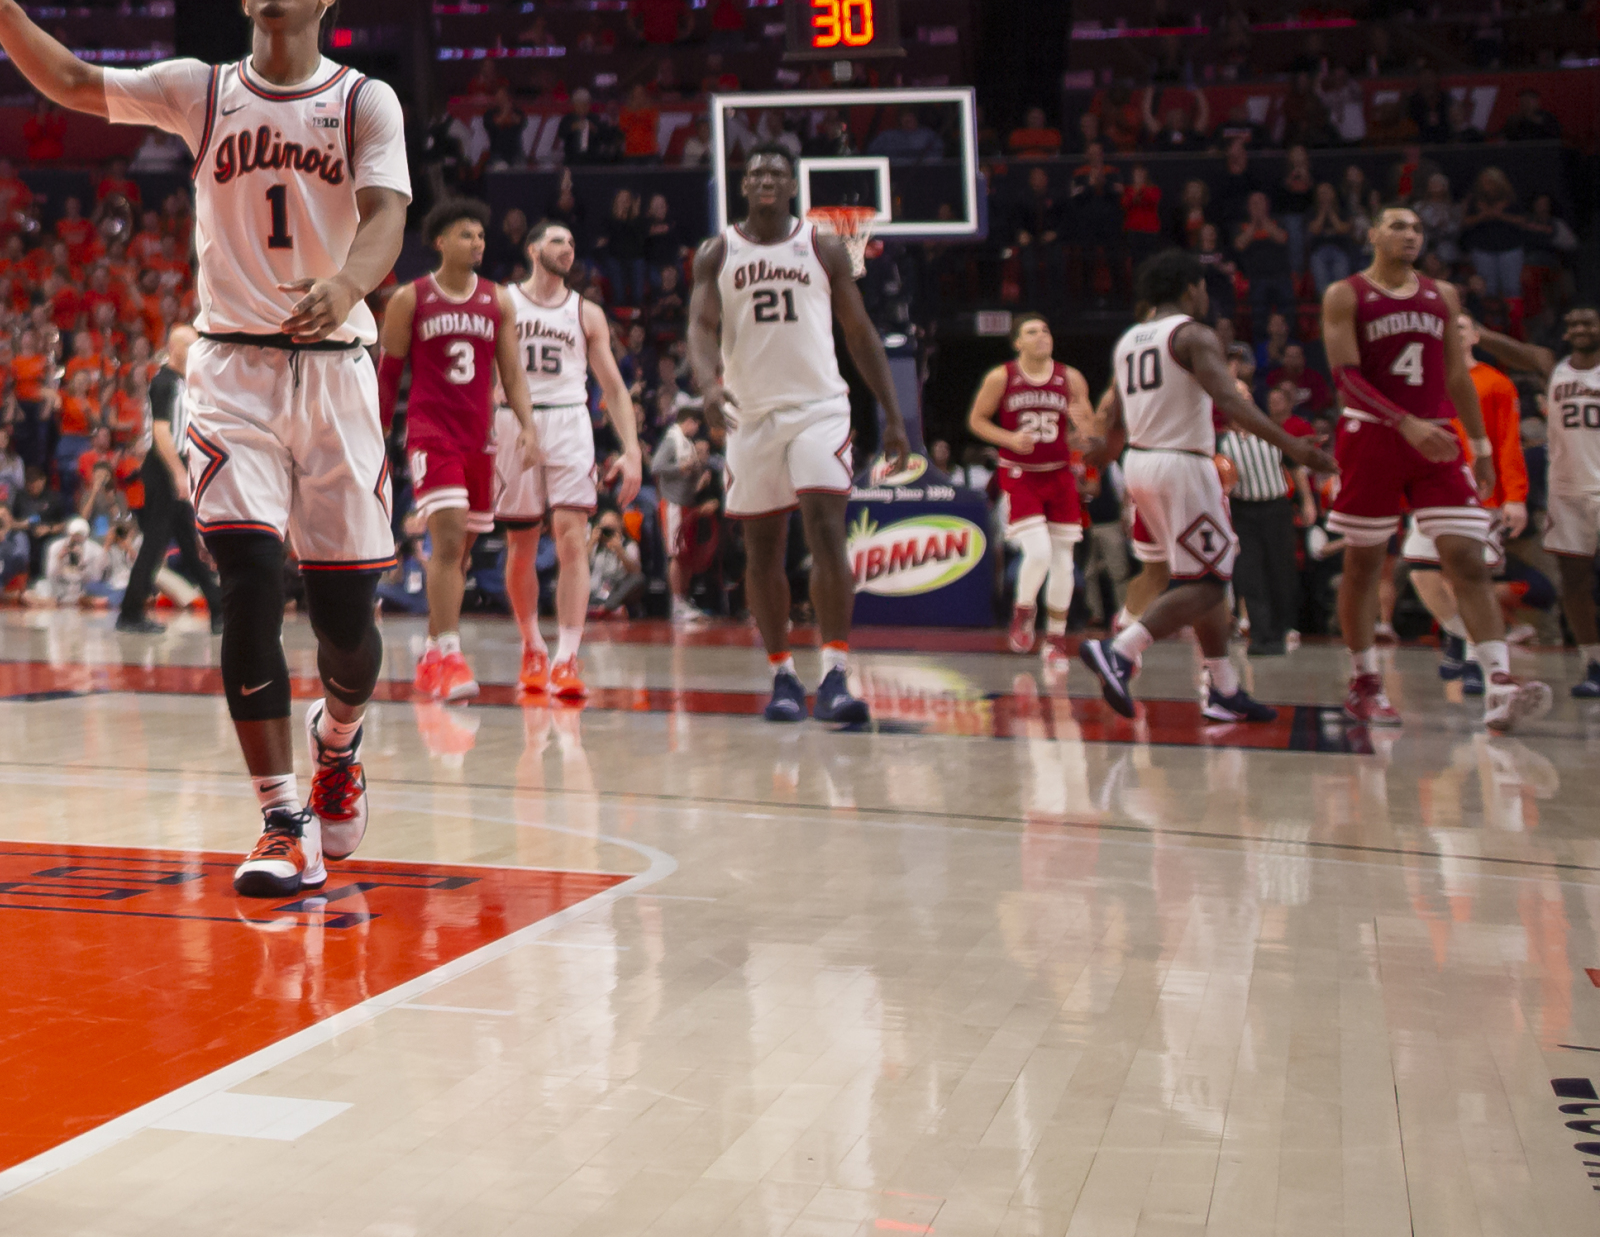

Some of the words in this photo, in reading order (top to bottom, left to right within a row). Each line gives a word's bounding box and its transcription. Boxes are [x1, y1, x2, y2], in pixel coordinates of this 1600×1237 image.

[213, 125, 345, 185] Illinois
[266, 183, 293, 250] 1
[734, 259, 811, 290] Illinois
[752, 288, 798, 324] 21
[420, 312, 495, 342] INDIANA
[448, 341, 476, 385] 3
[526, 343, 563, 375] 15
[1125, 346, 1163, 395] 10
[1391, 342, 1425, 386] 4
[1019, 411, 1060, 443] 25
[1562, 404, 1600, 428] 20
